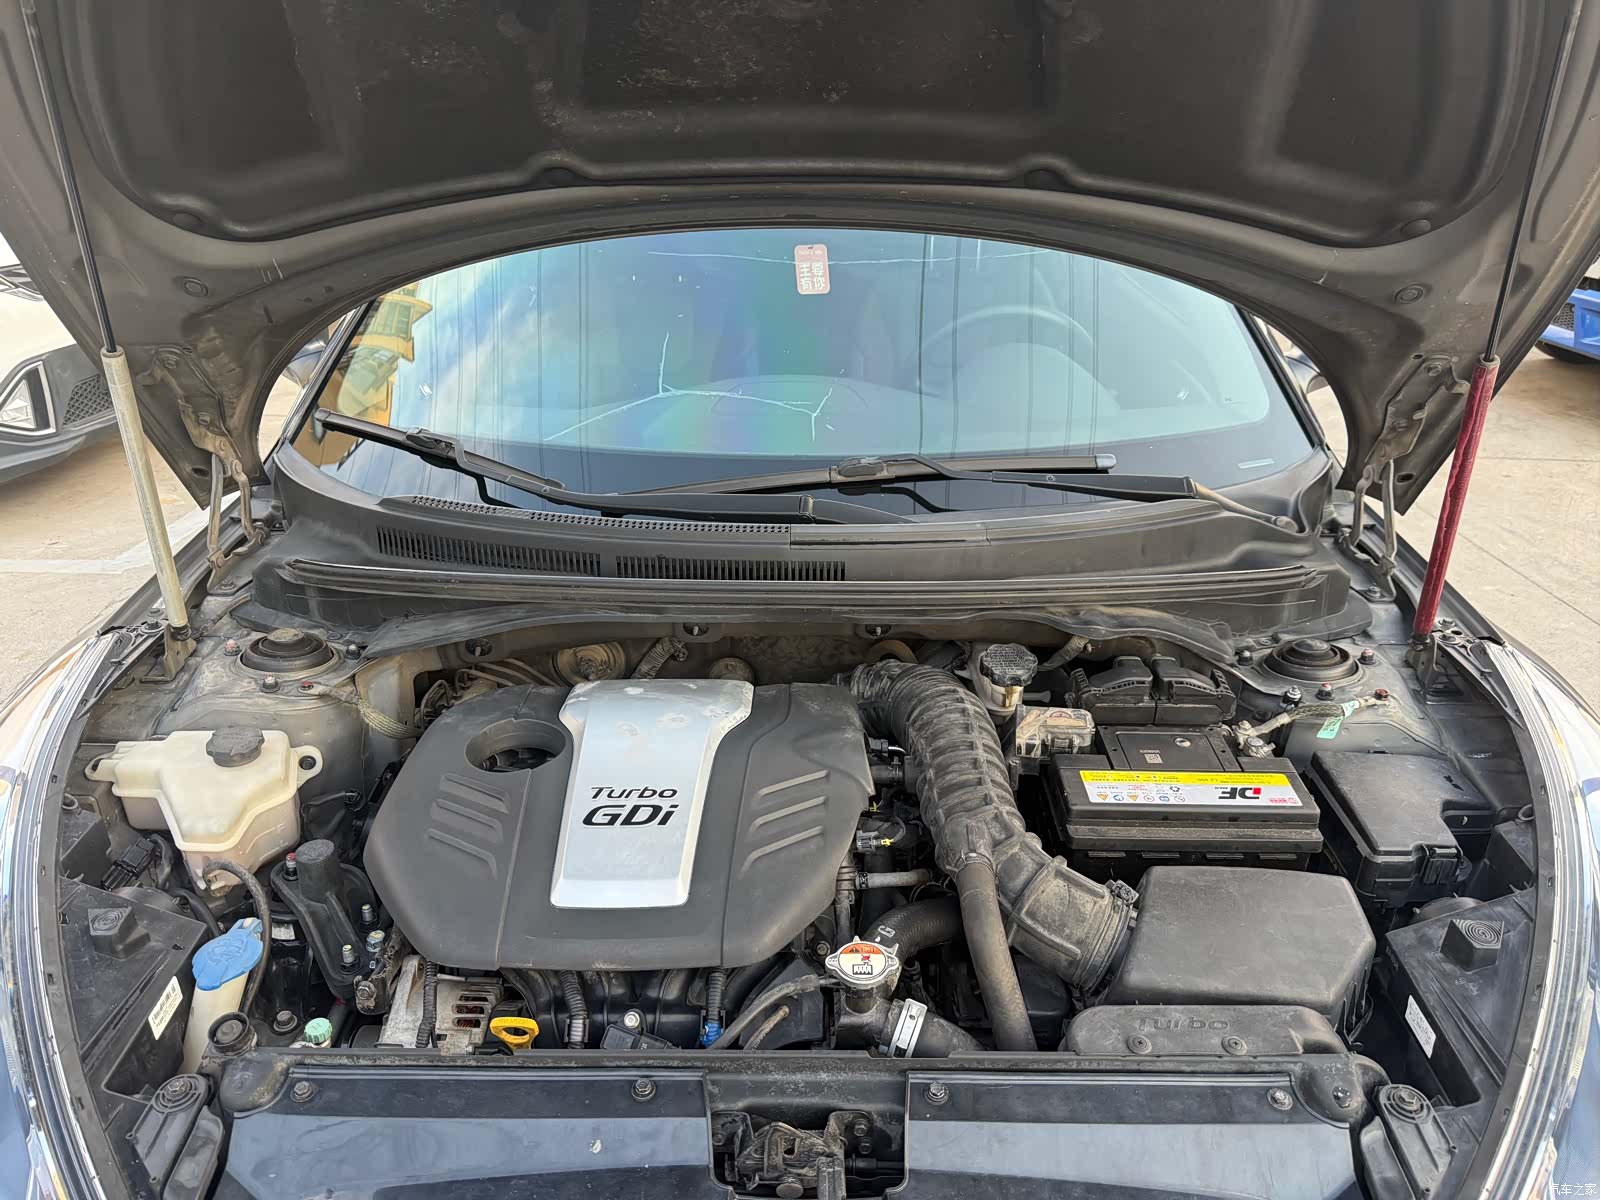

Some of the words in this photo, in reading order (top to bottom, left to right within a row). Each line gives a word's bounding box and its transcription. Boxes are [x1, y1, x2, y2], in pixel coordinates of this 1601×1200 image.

[591, 786, 678, 799] Turbo
[582, 804, 680, 826] GDi
[1135, 1016, 1229, 1032] Turbo
